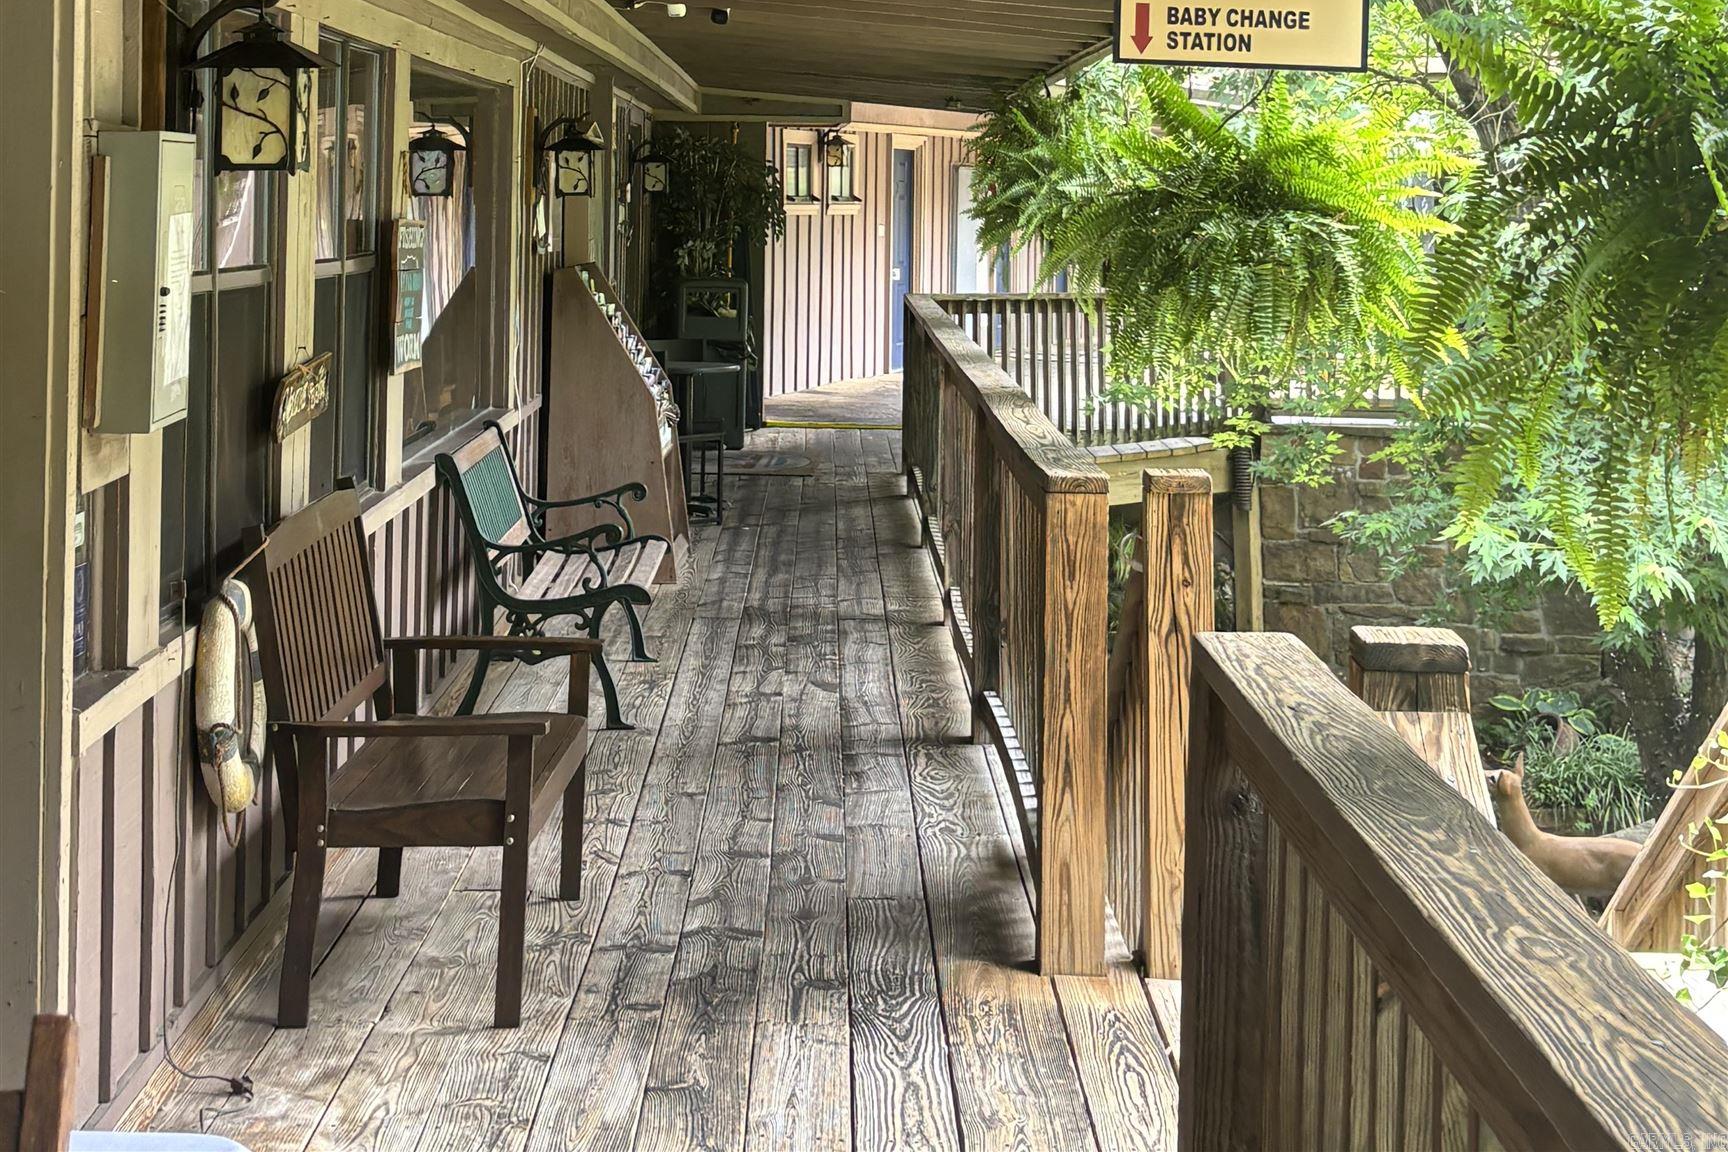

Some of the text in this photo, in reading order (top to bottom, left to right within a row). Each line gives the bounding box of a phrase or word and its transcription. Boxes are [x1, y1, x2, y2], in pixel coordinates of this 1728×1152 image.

[1167, 6, 1310, 30] BABY CHANGE
[1166, 31, 1252, 52] STATION
